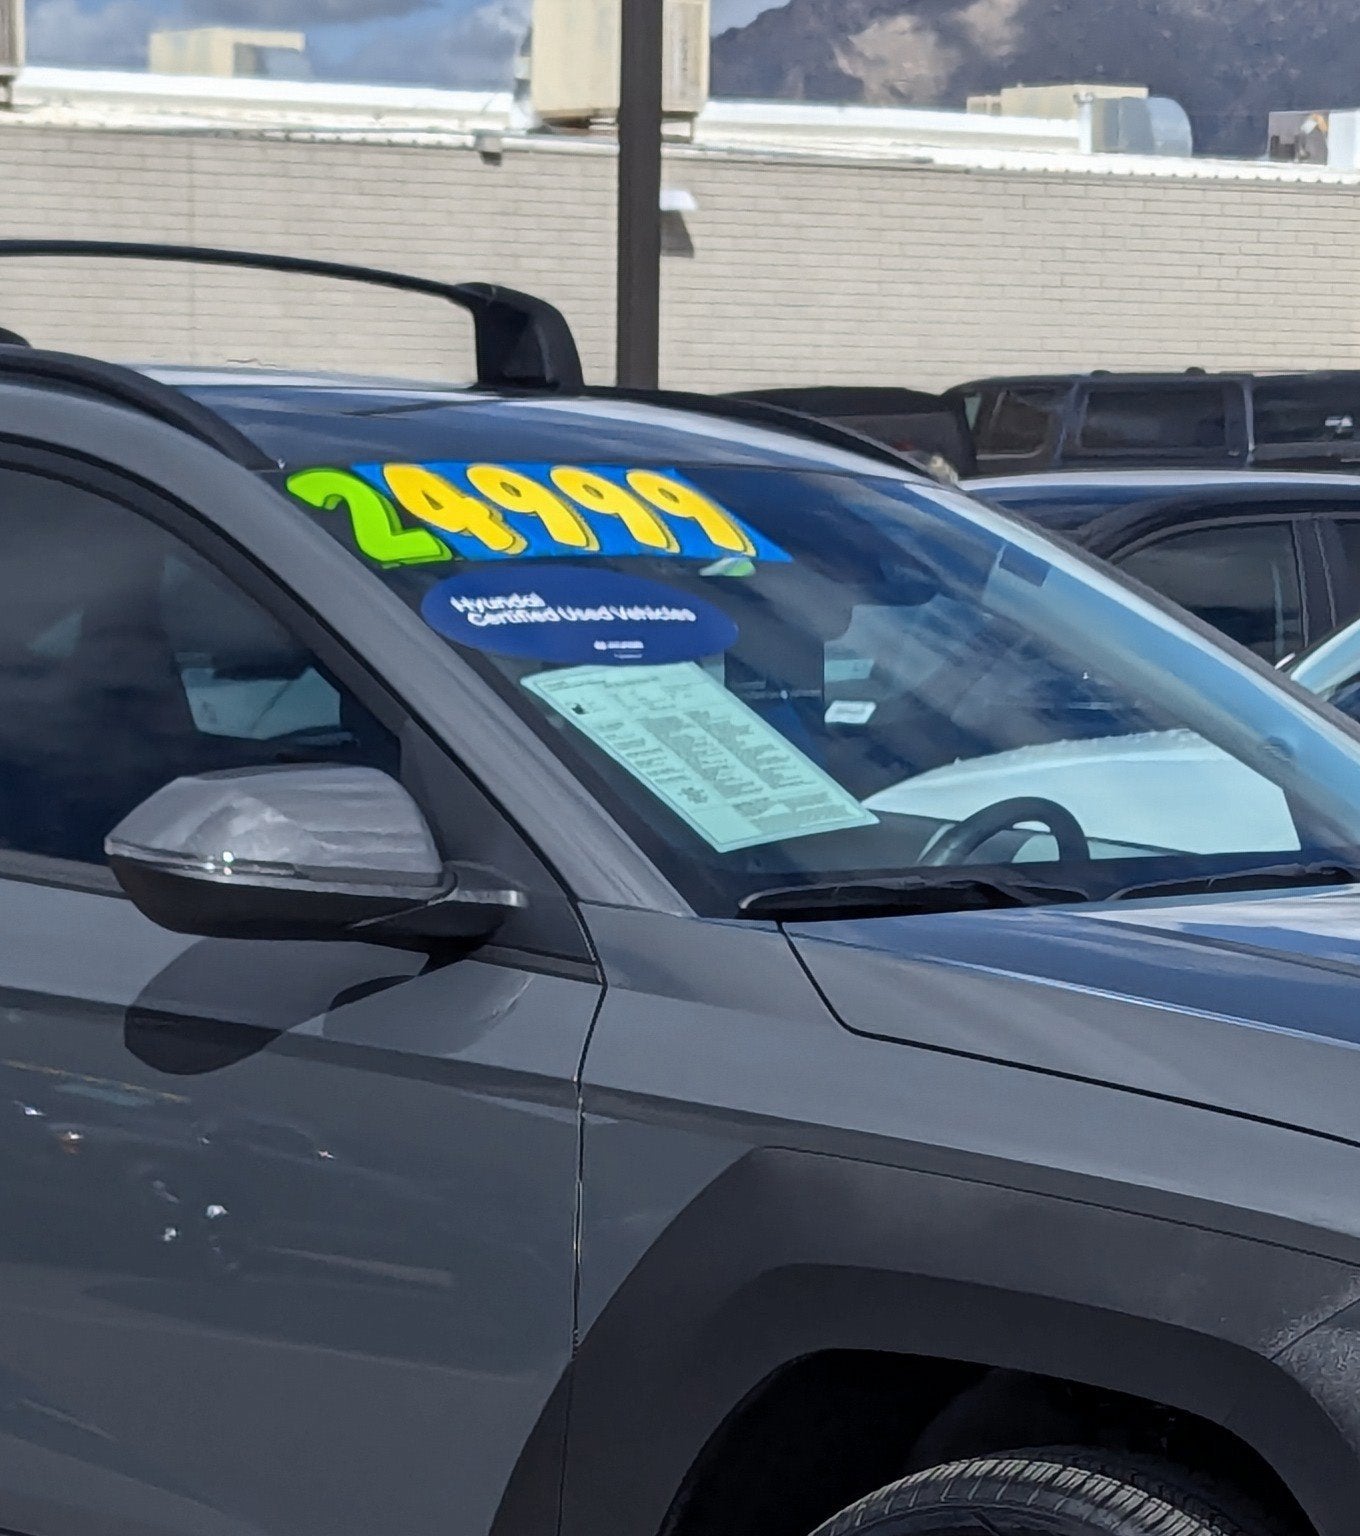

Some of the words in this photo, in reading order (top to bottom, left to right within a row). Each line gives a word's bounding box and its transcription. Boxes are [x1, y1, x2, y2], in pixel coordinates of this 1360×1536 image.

[286, 463, 757, 563] 24999
[467, 606, 560, 627] Certified
[556, 605, 615, 621] Used
